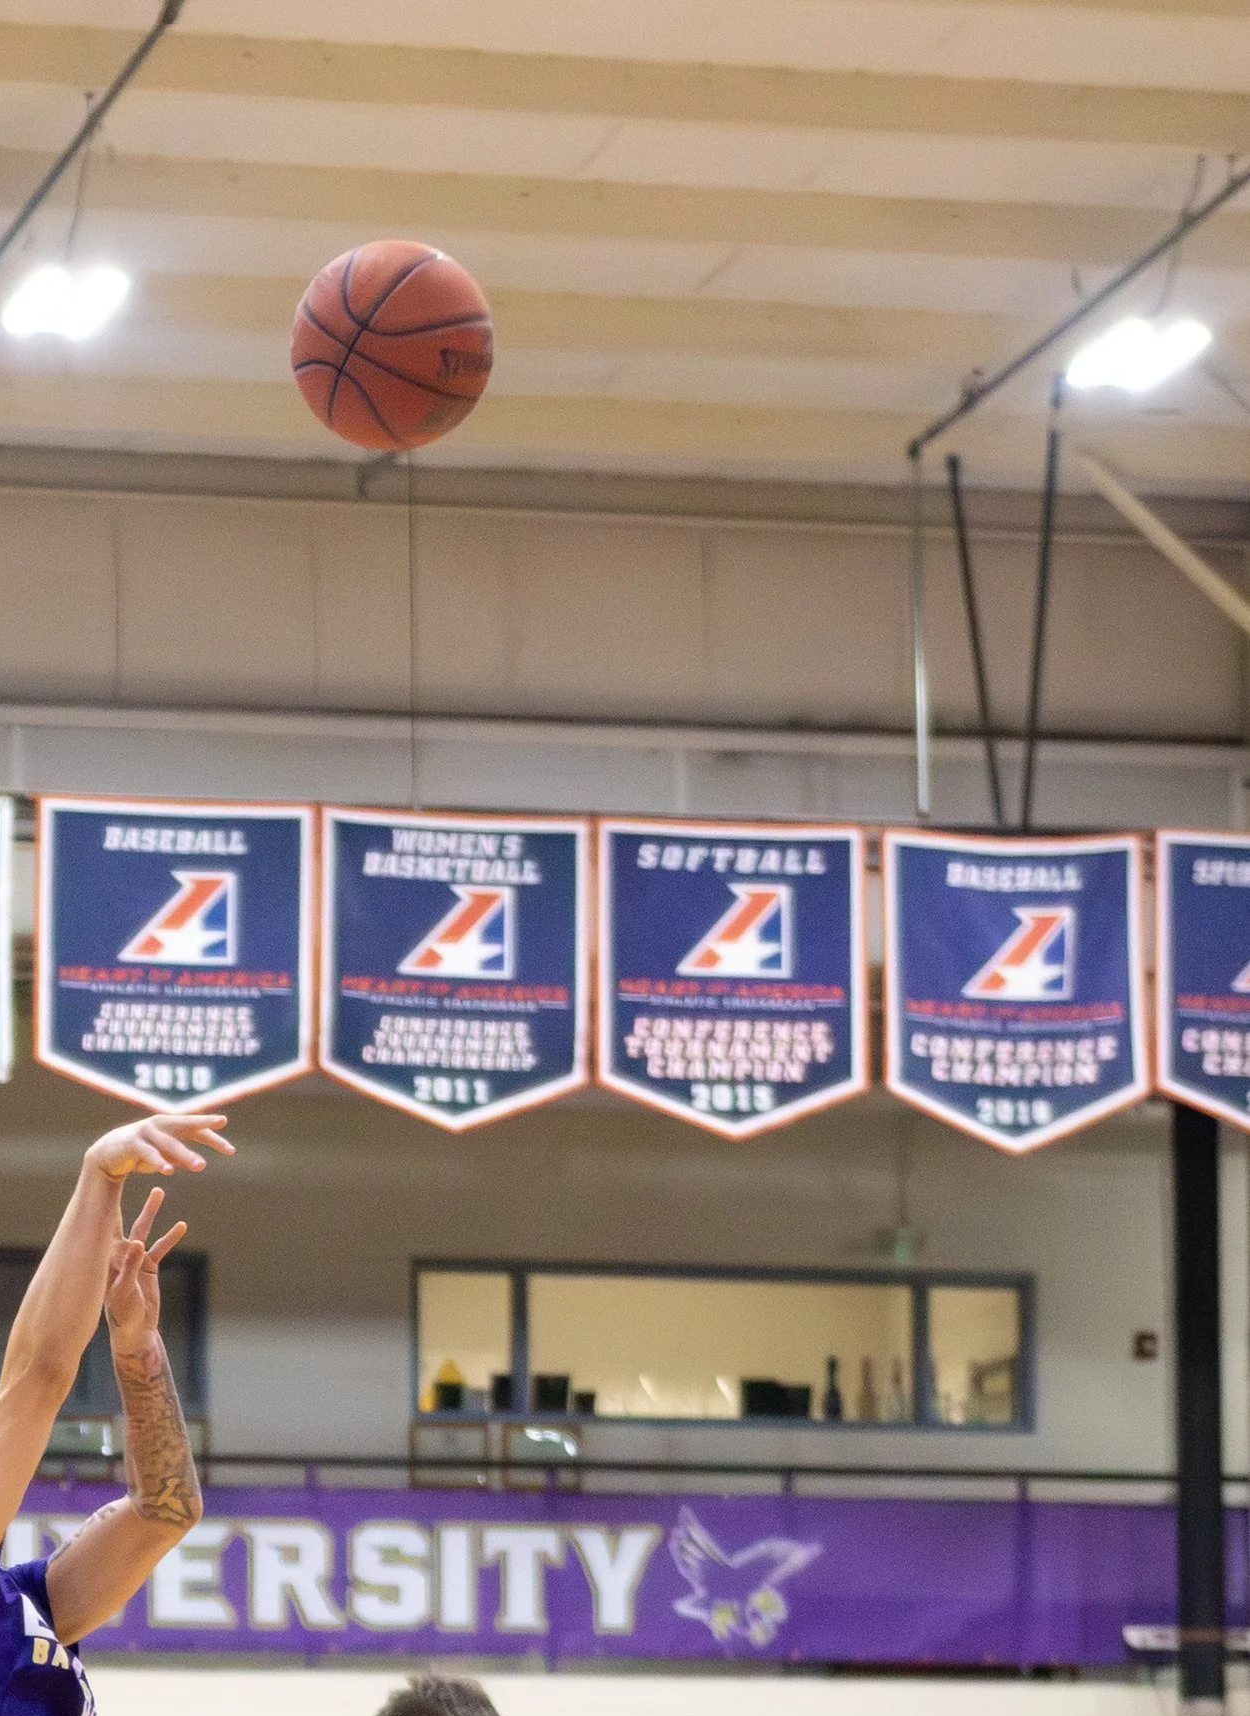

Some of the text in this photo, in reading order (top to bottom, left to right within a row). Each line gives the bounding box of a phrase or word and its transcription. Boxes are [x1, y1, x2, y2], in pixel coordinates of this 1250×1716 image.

[102, 825, 249, 855] BASEBALL
[362, 851, 542, 885] BASKETBALL
[637, 843, 827, 875] SOFTBALL
[946, 861, 1084, 892] BASEBALL
[134, 1063, 212, 1092] 2010
[930, 1060, 1099, 1087] CHAMPION
[413, 1075, 490, 1105] 2011
